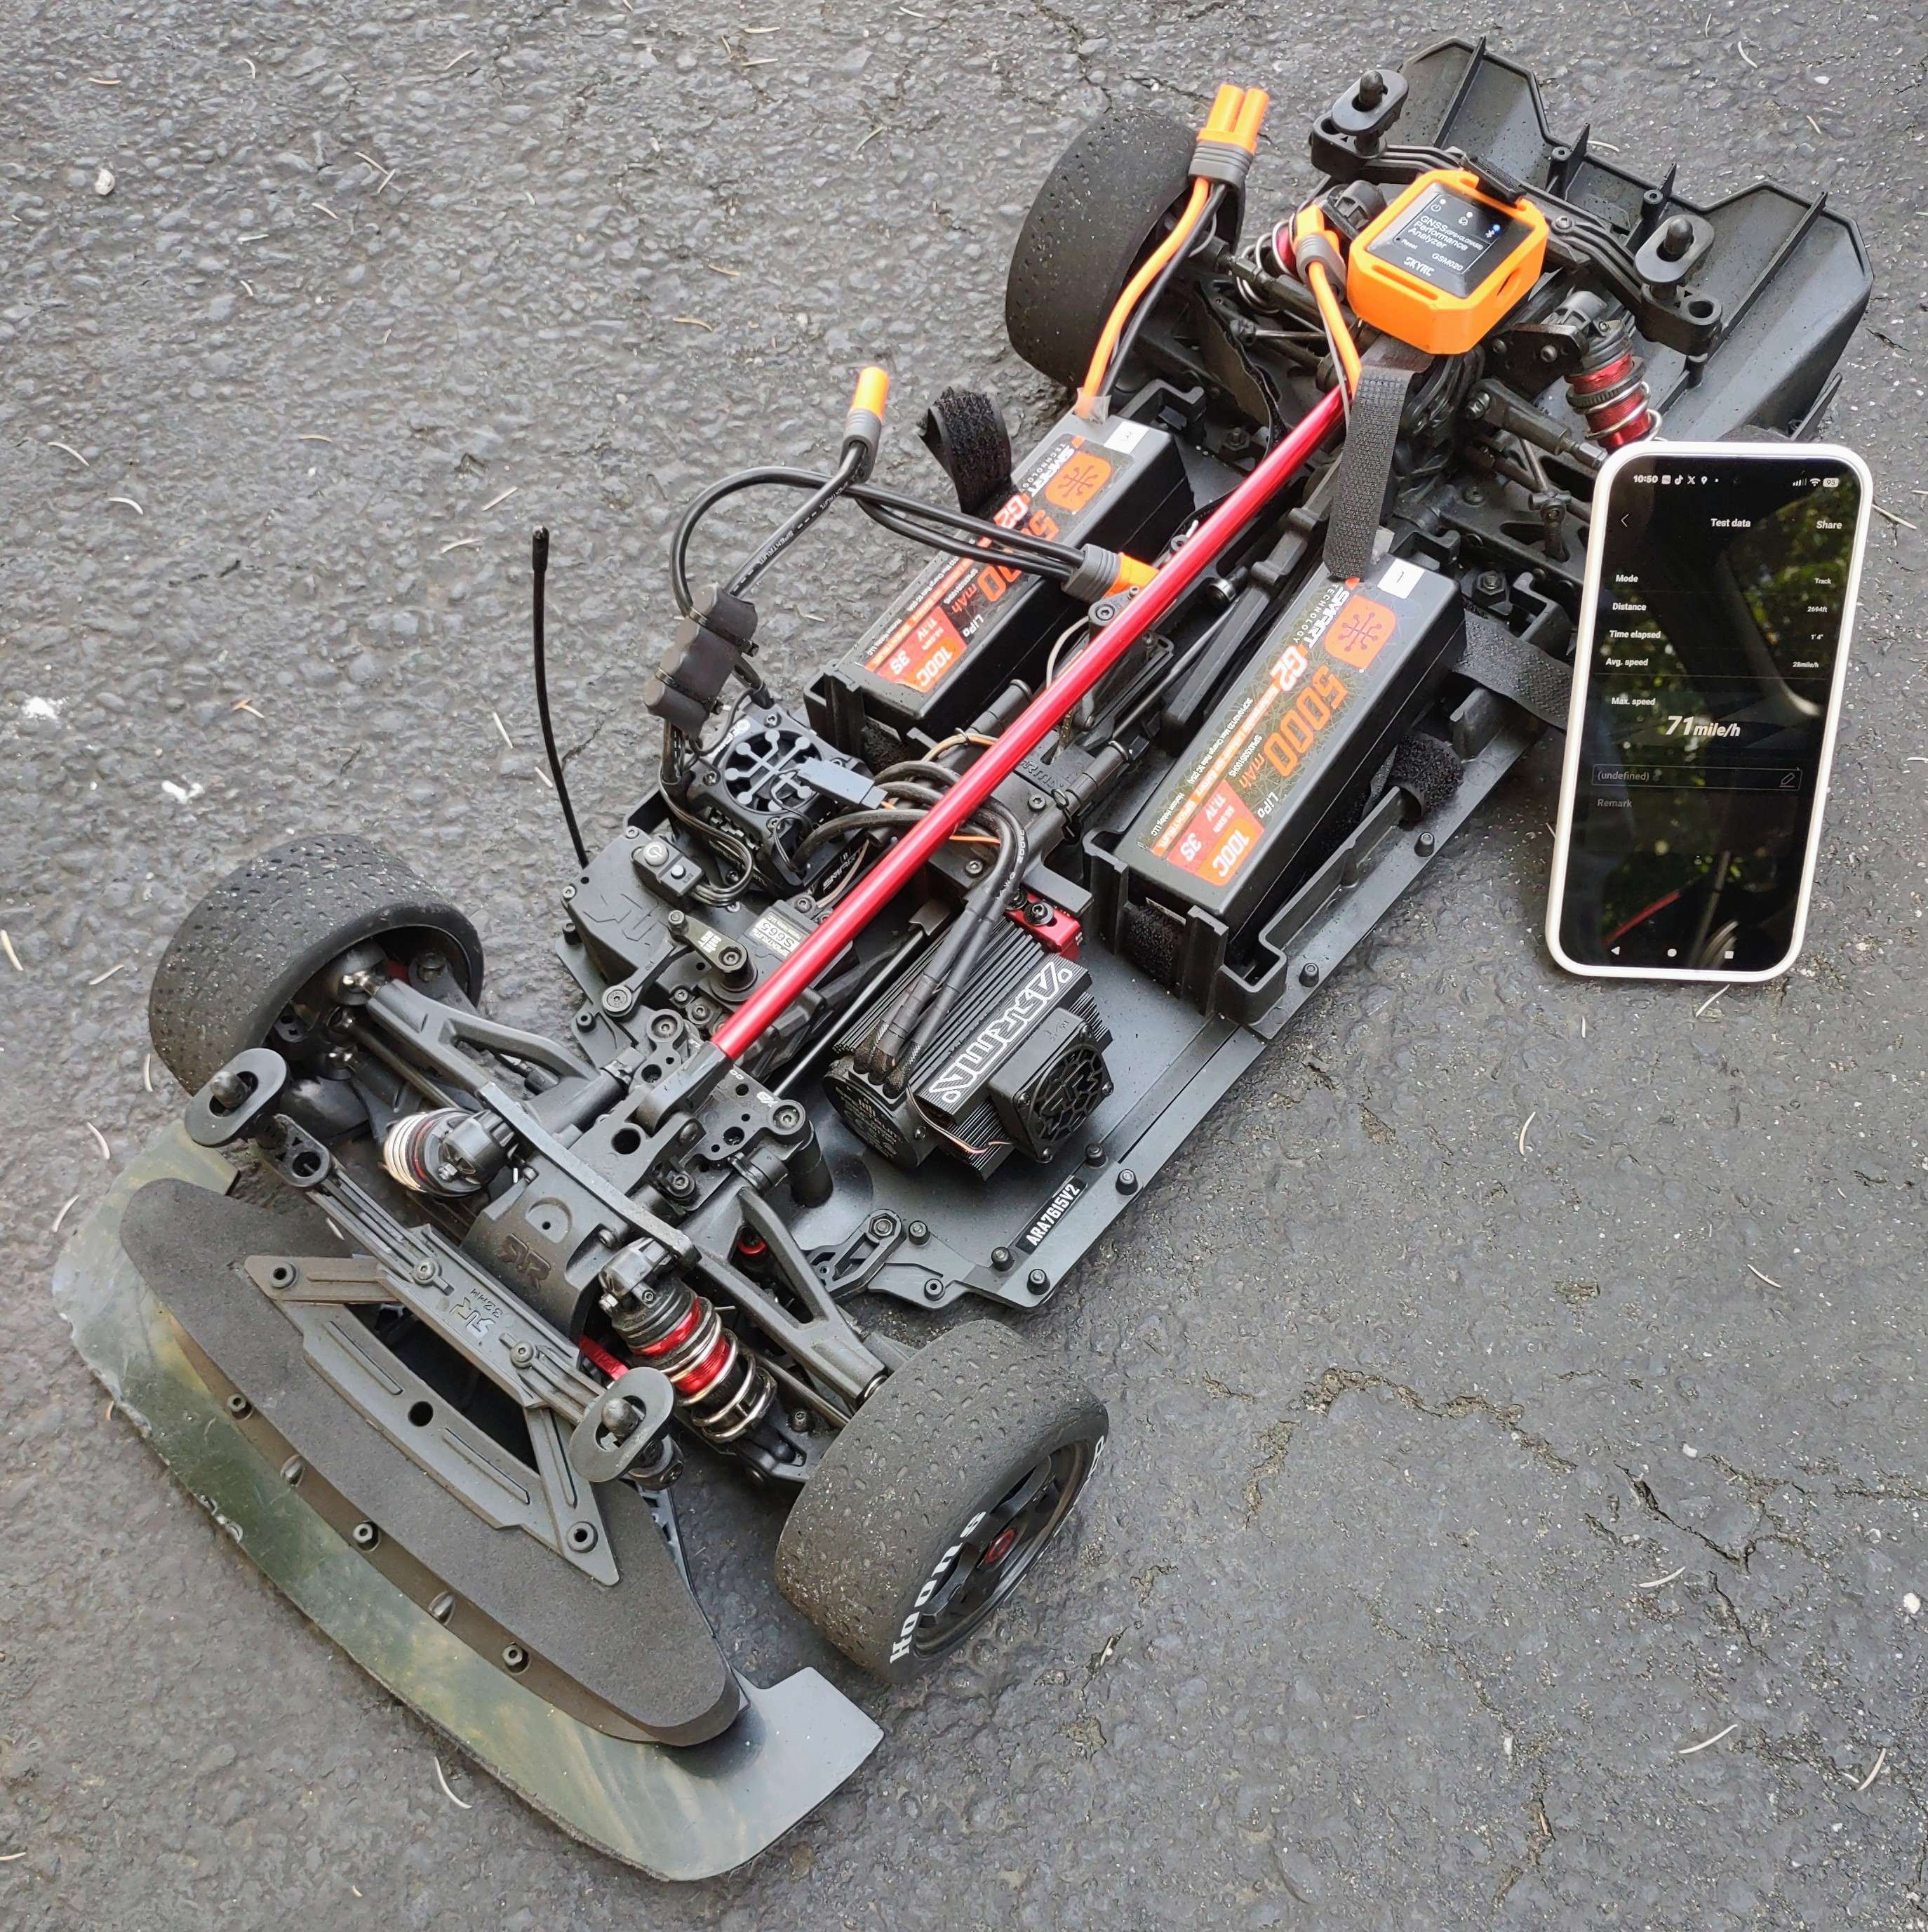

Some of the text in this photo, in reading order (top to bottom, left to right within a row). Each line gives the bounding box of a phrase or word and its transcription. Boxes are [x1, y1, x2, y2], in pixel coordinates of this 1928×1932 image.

[1414, 221, 1468, 250] Performance
[1419, 215, 1447, 232] GNSS
[1407, 227, 1447, 248] Analyzer
[1403, 256, 1435, 277] SKYRC
[1431, 252, 1464, 271] GSM020
[1633, 475, 1658, 484] 10:50
[993, 494, 1029, 529] G2
[1732, 519, 1750, 528] data
[1816, 521, 1842, 529] Share
[951, 581, 978, 614] mAh
[1292, 583, 1337, 643] TECHNOLOGY
[1308, 585, 1351, 648] SMART
[1631, 631, 1661, 640] elapsed
[888, 649, 912, 674] 3S
[916, 645, 953, 686] 100C
[1269, 646, 1308, 692] G2
[1625, 658, 1649, 667] speed
[1239, 665, 1348, 789] 5000 mAh
[1598, 771, 1649, 782] (undefined)
[1167, 792, 1184, 811] Horizon
[1205, 794, 1226, 821] 11.1V
[1257, 790, 1279, 818] LiPo
[1598, 799, 1632, 807] Remark
[1150, 824, 1160, 836] LLC
[1179, 832, 1203, 862] 3S
[1212, 828, 1250, 878] 100C
[760, 921, 795, 948] S665
[928, 959, 1064, 1095] ARRMA
[1027, 1183, 1080, 1246] ARA7615V2
